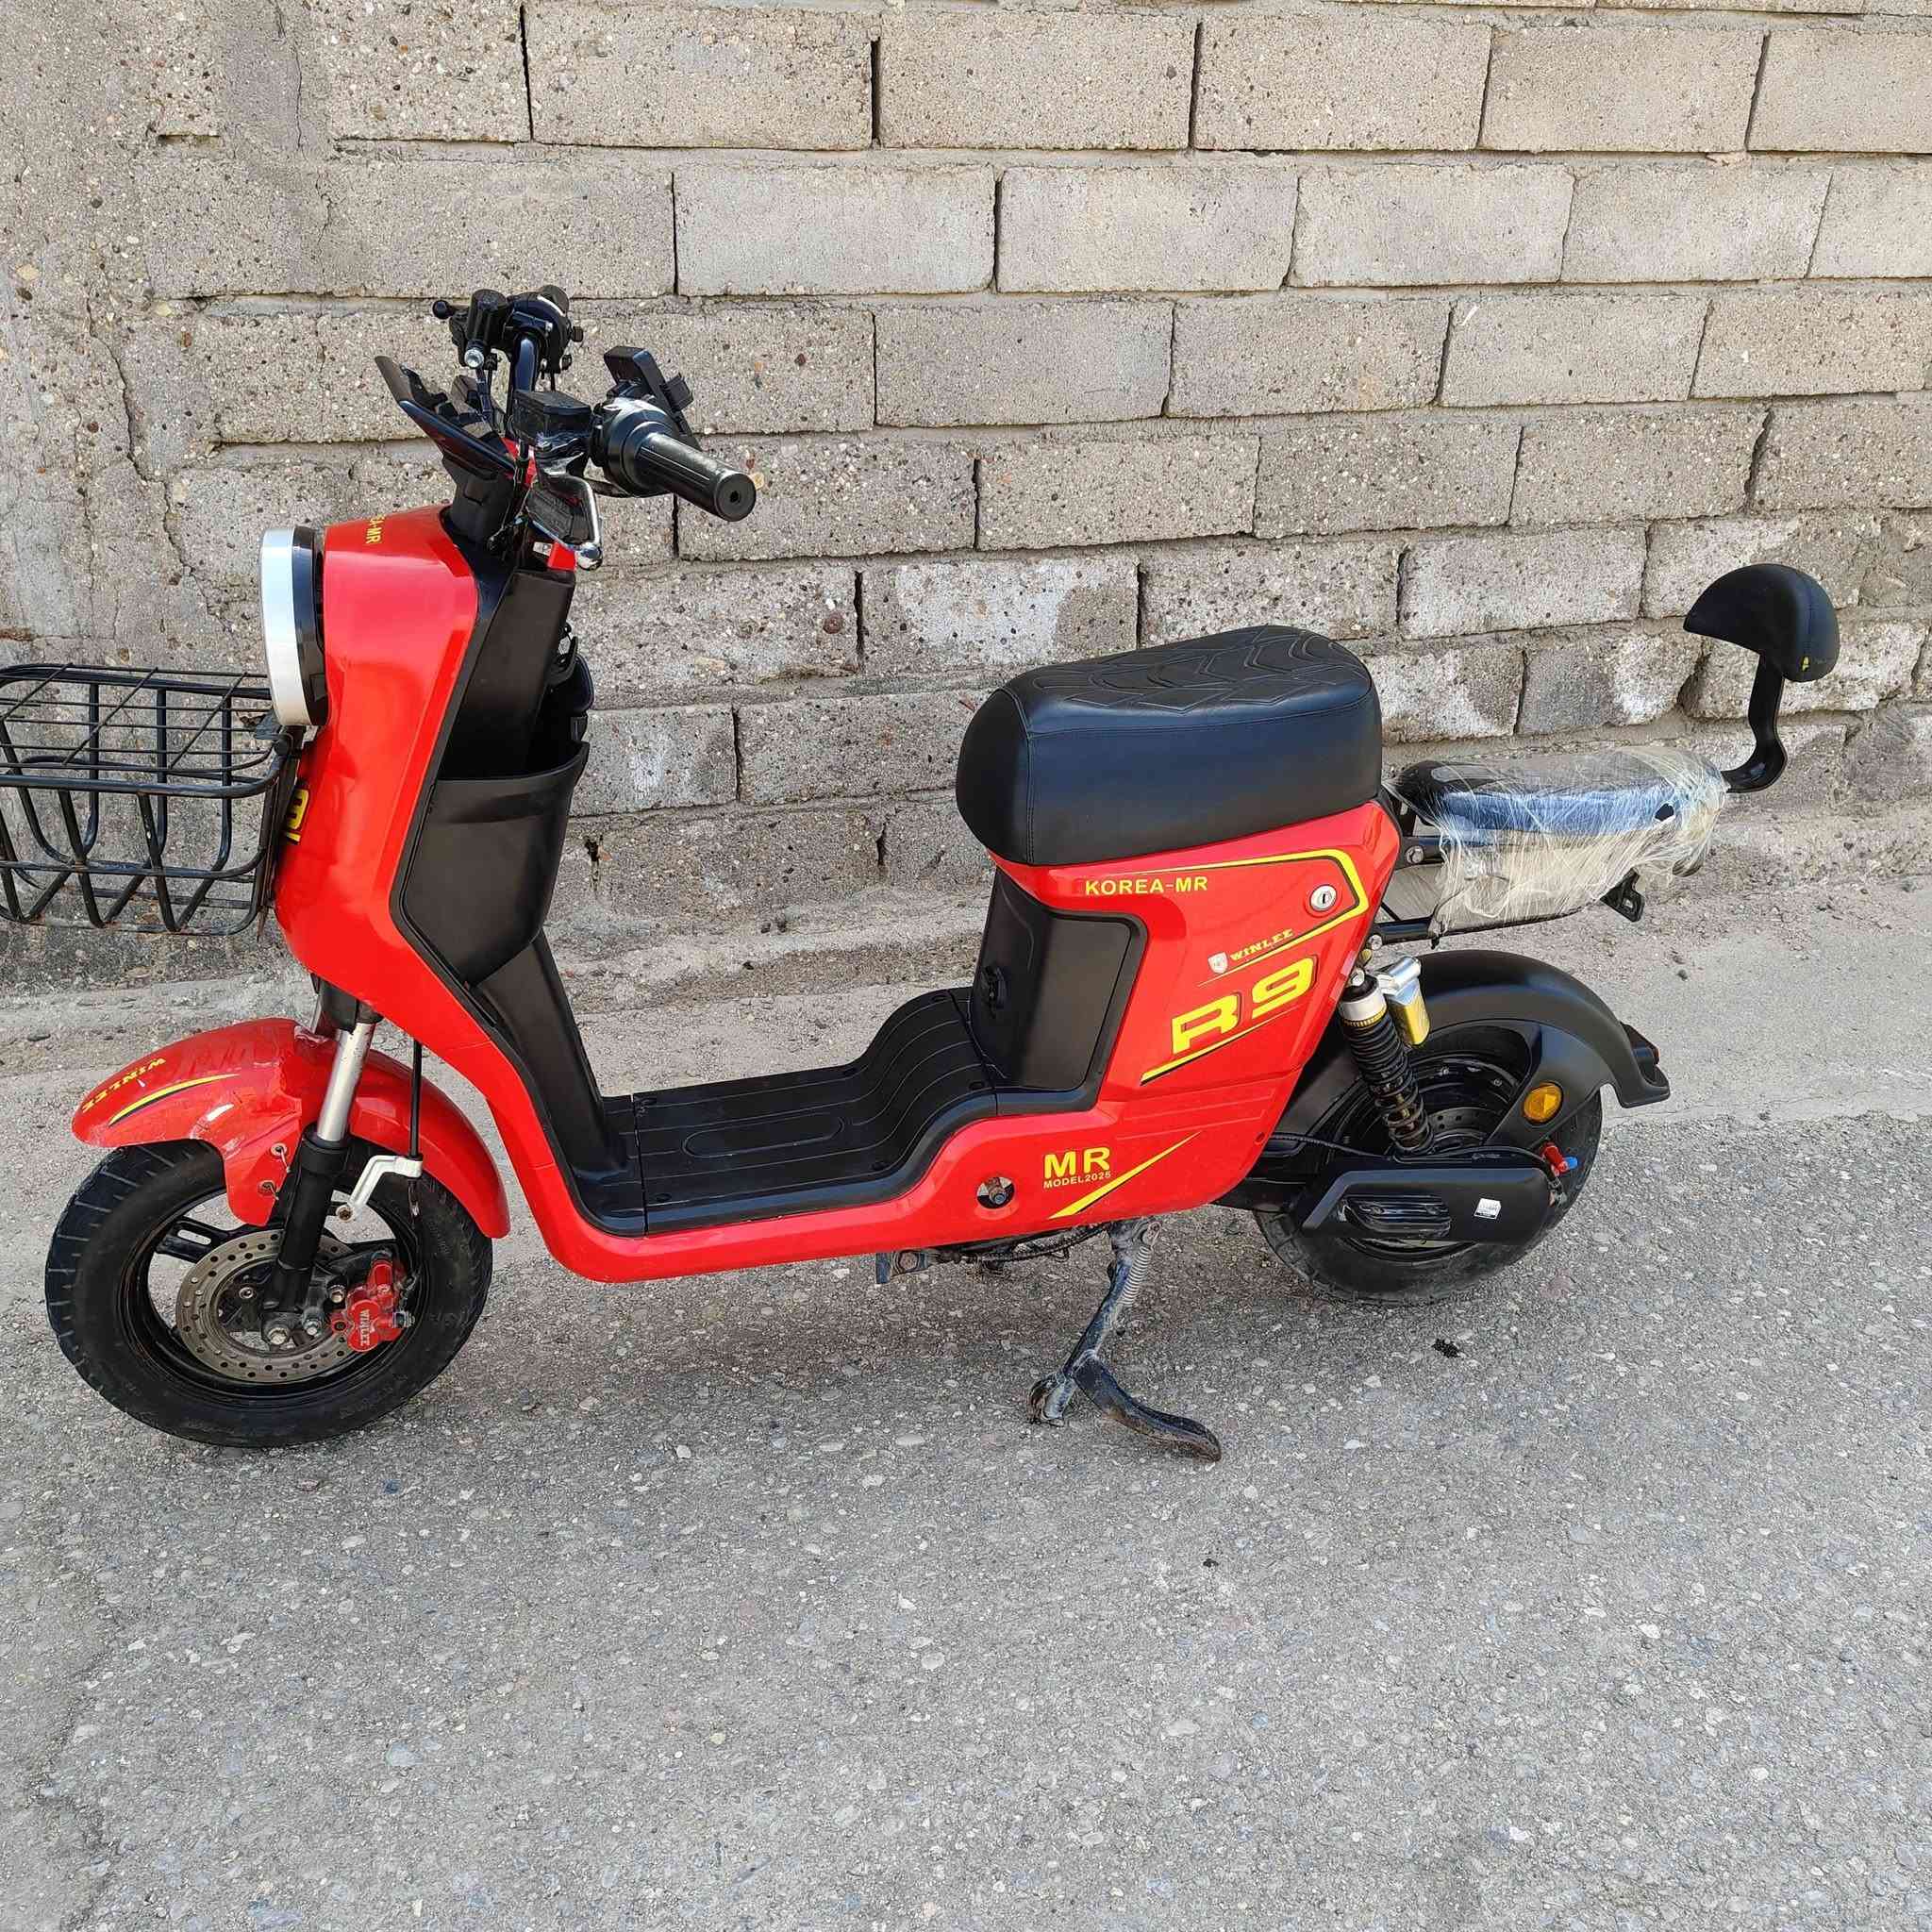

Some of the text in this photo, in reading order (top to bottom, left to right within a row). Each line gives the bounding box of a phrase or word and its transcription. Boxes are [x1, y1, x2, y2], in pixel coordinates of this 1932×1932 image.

[1085, 876, 1208, 895] KOREA-MR
[1229, 928, 1292, 960] WINLEE
[1044, 1147, 1110, 1178] MR
[1043, 1171, 1111, 1189] MODEL2025
